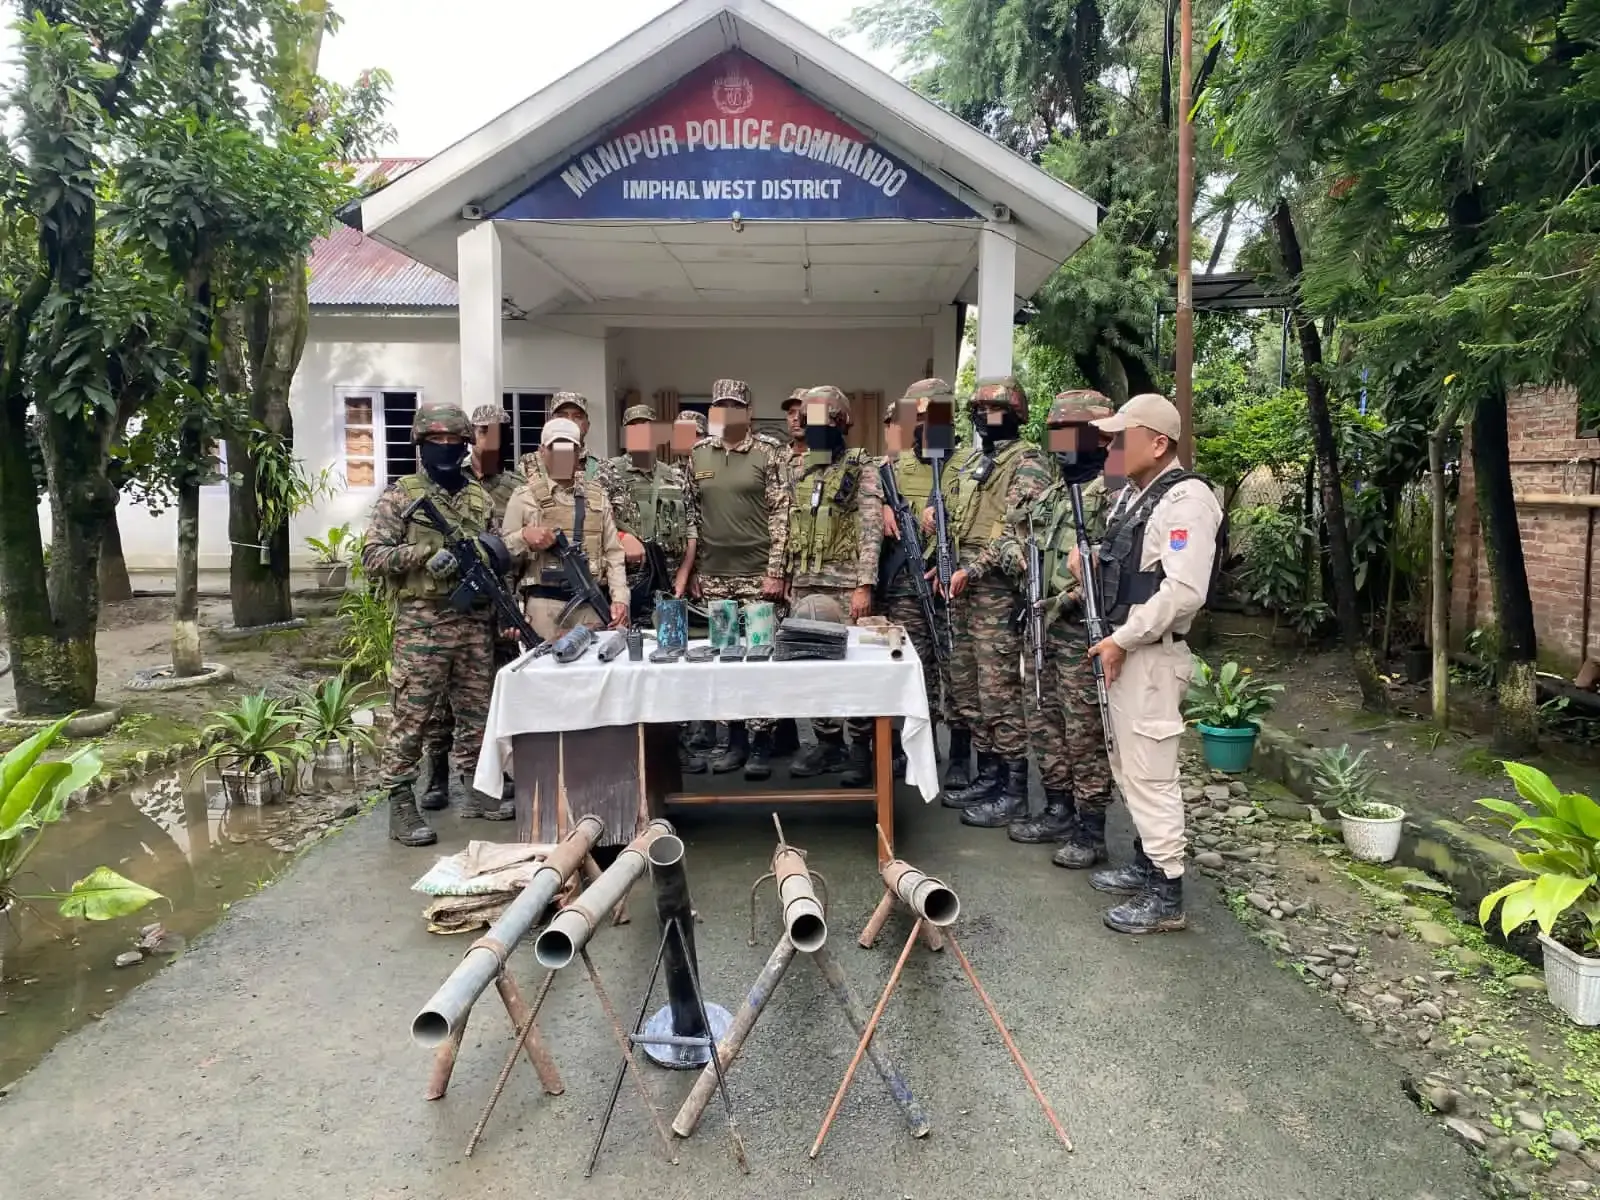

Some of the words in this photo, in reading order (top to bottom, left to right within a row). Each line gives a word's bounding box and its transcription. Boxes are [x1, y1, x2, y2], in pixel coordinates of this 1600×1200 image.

[560, 125, 679, 198] MANIPUR
[686, 118, 773, 152] POLICE
[779, 122, 908, 197] COMMANDO
[623, 179, 700, 200] IMPHAL
[702, 179, 756, 200] WEST
[762, 179, 842, 200] DISTRICT
